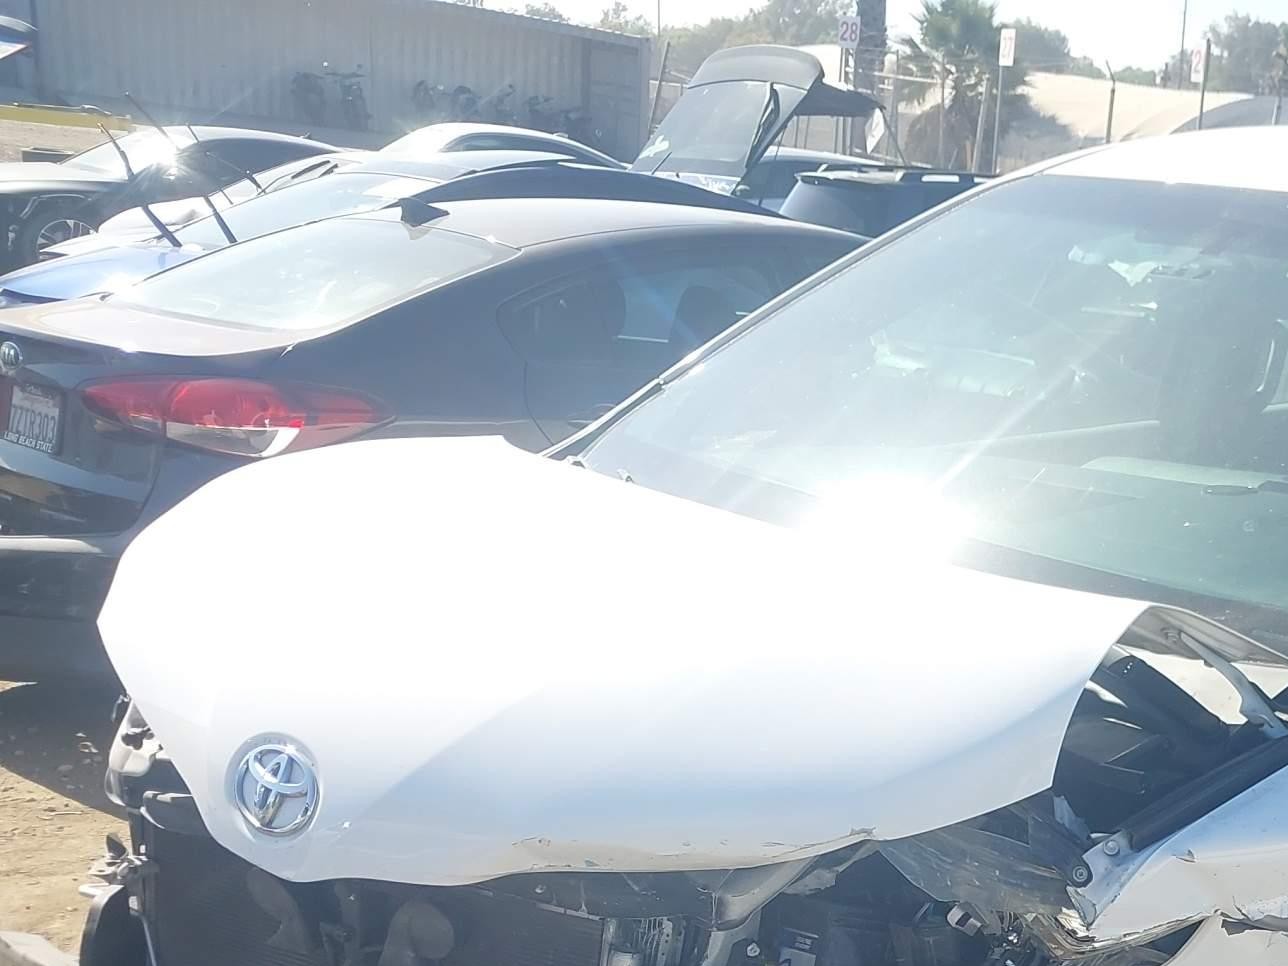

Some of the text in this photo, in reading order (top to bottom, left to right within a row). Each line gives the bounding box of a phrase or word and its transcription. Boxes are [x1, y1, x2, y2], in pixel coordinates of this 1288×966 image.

[840, 21, 858, 42] 28
[4, 430, 53, 453] LONG BEACH STATE
